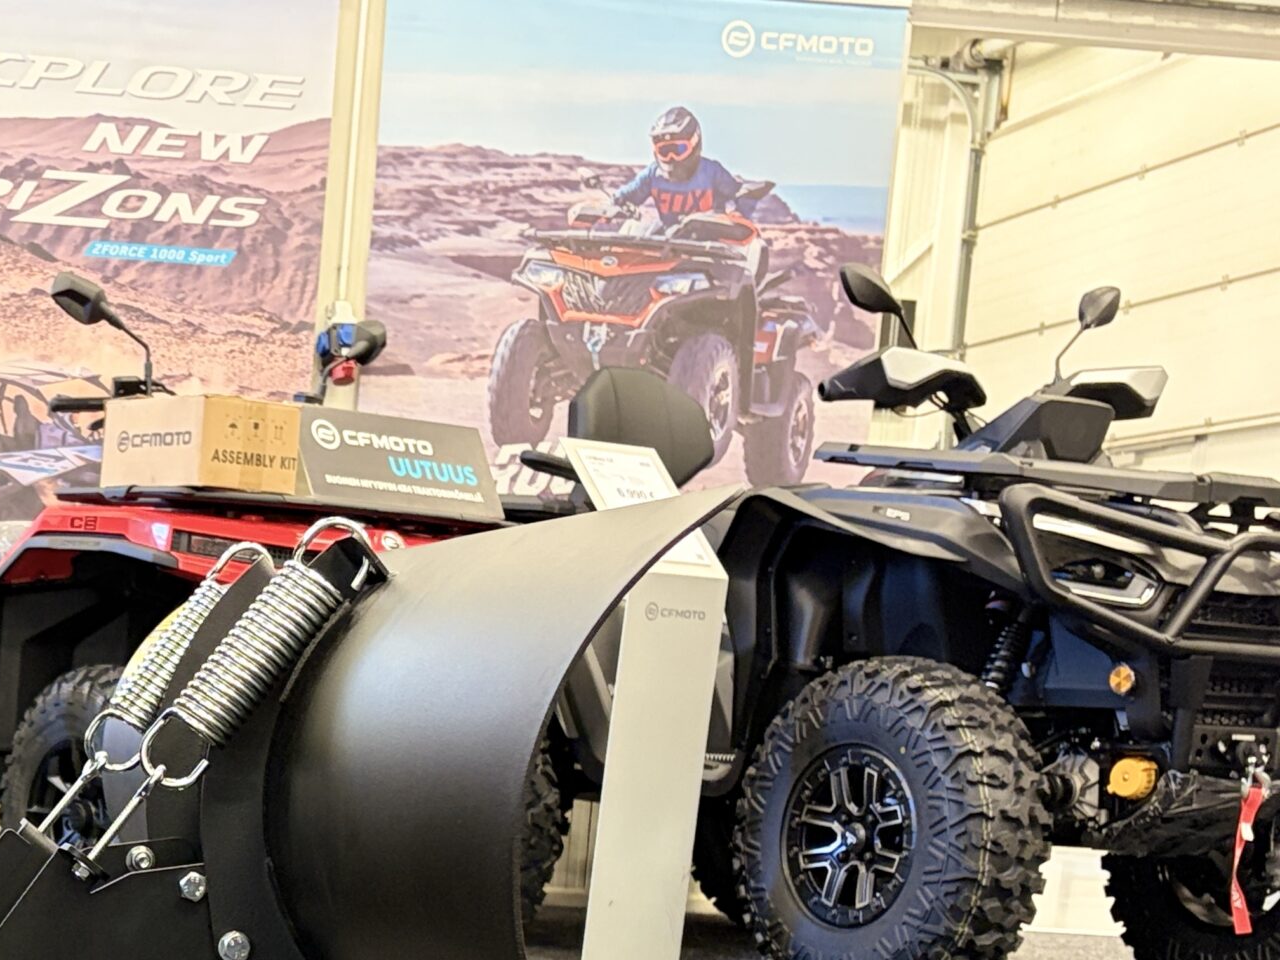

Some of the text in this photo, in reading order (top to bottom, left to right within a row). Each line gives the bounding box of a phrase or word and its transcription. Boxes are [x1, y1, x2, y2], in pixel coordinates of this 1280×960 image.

[760, 30, 875, 58] CFMOTO
[82, 122, 270, 164] NEW
[92, 243, 227, 265] ZFORCE 1000 Sport
[131, 430, 192, 448] CFMOTO
[342, 429, 433, 456] CFMOTO
[211, 448, 297, 471] ASSEMBLY KIT
[388, 455, 478, 486] UUTUUS
[660, 607, 707, 621] CFMOTO
